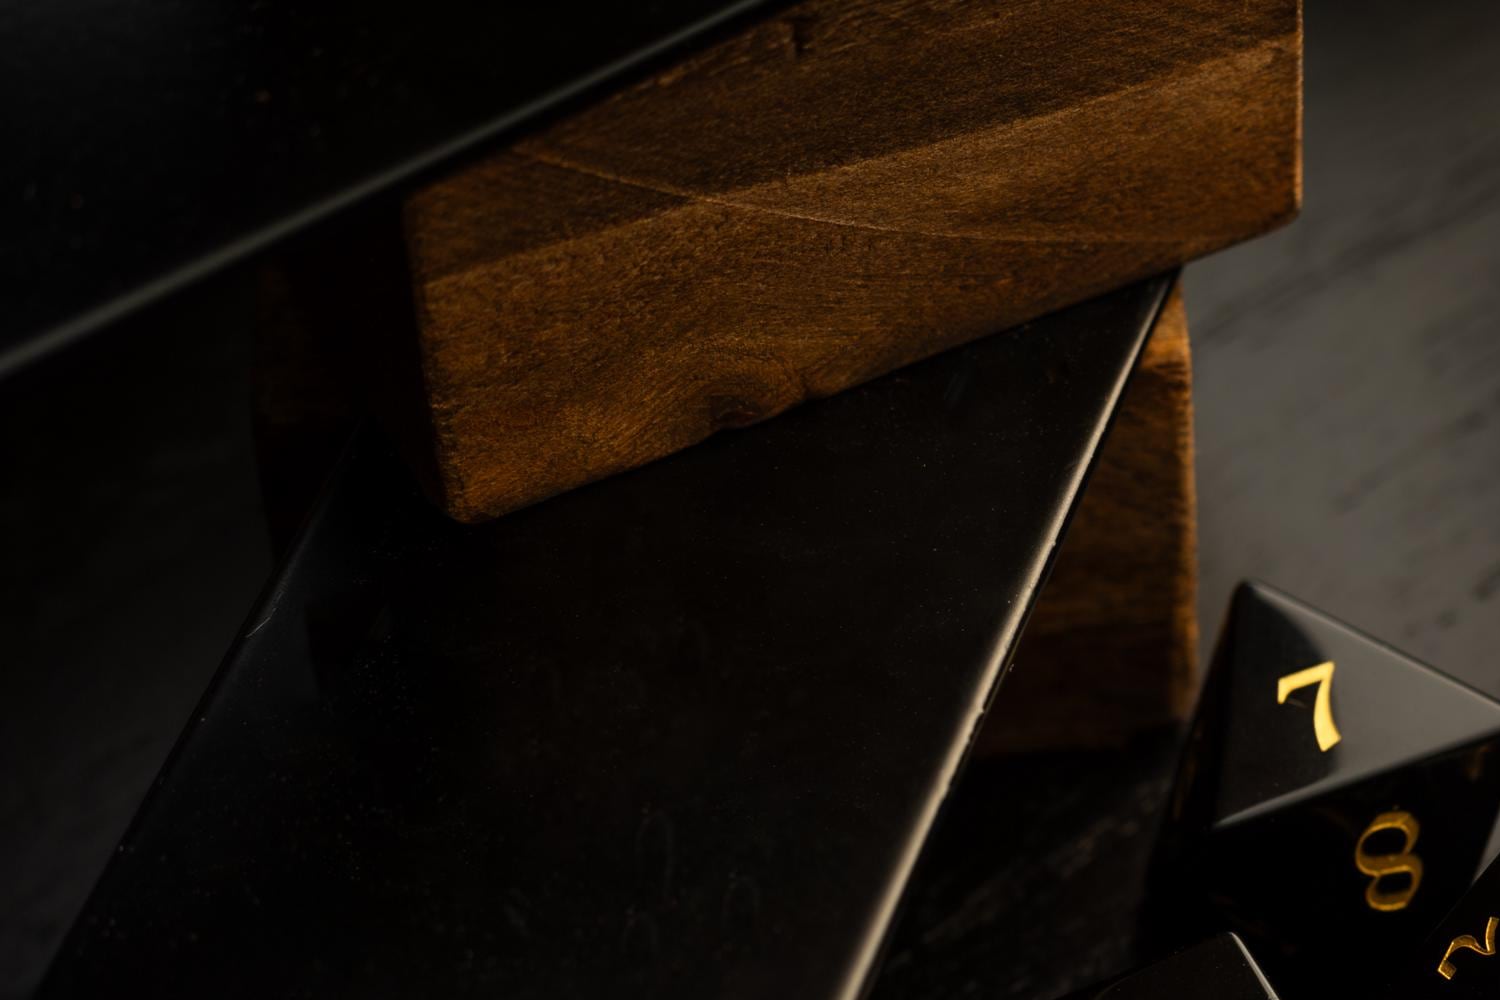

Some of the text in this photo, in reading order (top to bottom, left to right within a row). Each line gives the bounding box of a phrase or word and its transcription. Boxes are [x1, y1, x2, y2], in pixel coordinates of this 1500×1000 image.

[1275, 659, 1343, 754] 7
[1354, 810, 1423, 913] 8
[1435, 915, 1500, 982] 2
